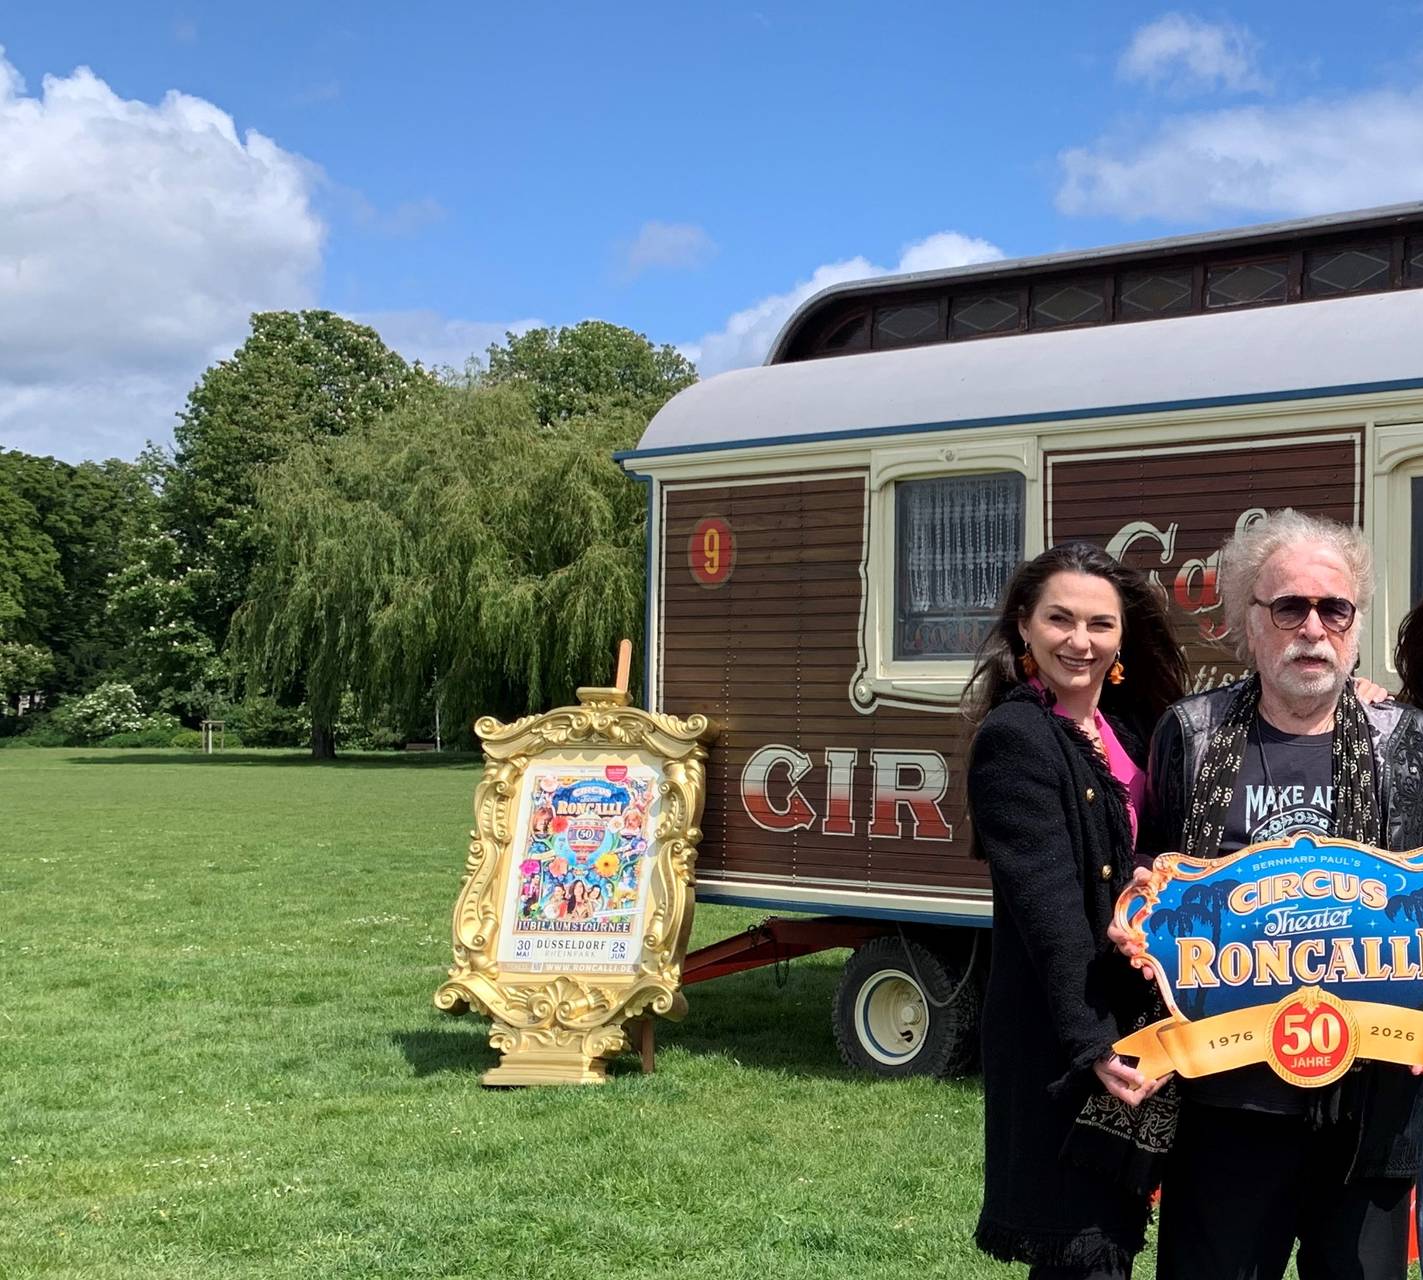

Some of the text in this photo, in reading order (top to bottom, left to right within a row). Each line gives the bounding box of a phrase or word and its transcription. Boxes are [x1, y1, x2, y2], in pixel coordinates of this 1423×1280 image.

[703, 527, 720, 575] 9
[1104, 508, 1268, 641] Ca
[741, 744, 953, 842] CIR
[1245, 785, 1305, 834] MAKE
[1252, 855, 1361, 872] BERNHARD PAUL'S
[1227, 869, 1389, 916] CIRCUS
[1264, 905, 1353, 936] Theater
[517, 940, 531, 950] 30
[612, 942, 626, 952] 28
[1207, 1030, 1254, 1051] 1976
[1279, 1012, 1343, 1057] 50
[1370, 1025, 1416, 1042] 2026
[1290, 1056, 1332, 1069] JAHRE
